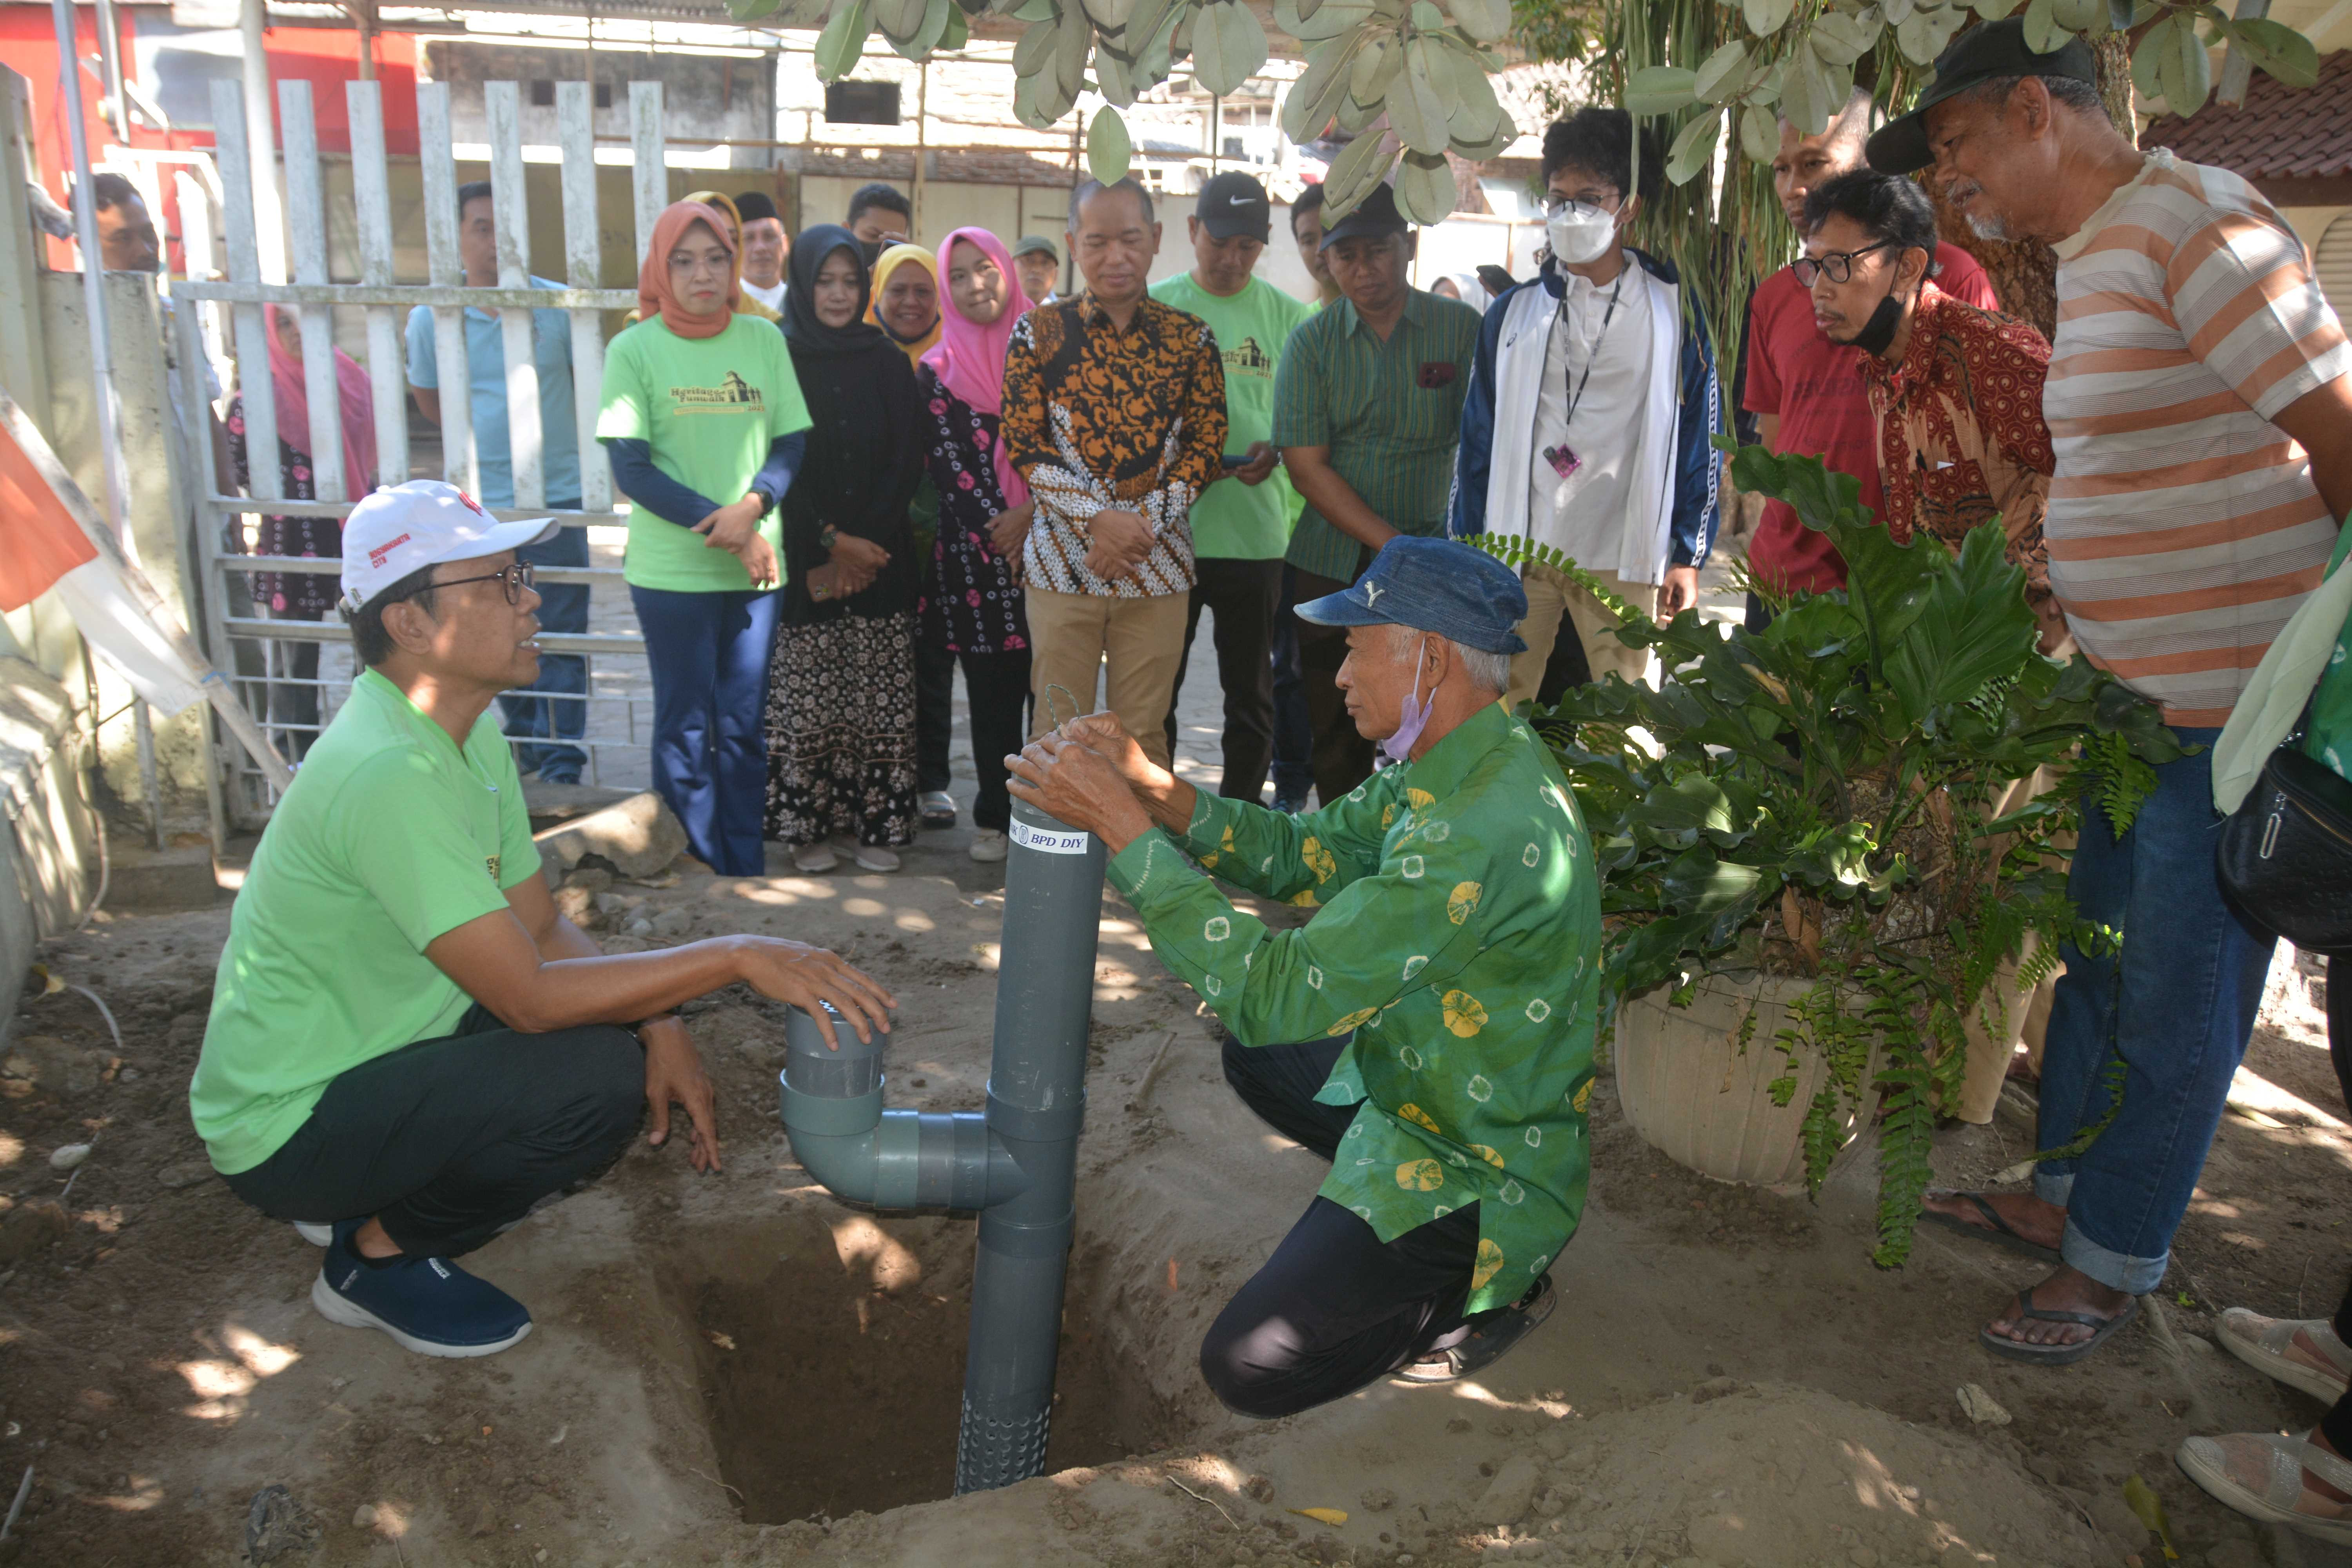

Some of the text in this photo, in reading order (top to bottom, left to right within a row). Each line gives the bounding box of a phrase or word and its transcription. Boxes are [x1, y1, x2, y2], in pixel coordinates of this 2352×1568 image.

[671, 387, 725, 396] Heritage
[680, 394, 725, 403] Funwalk
[372, 556, 387, 569] CITY
[1031, 834, 1056, 846] BPD
[1060, 838, 1084, 848] DIY
